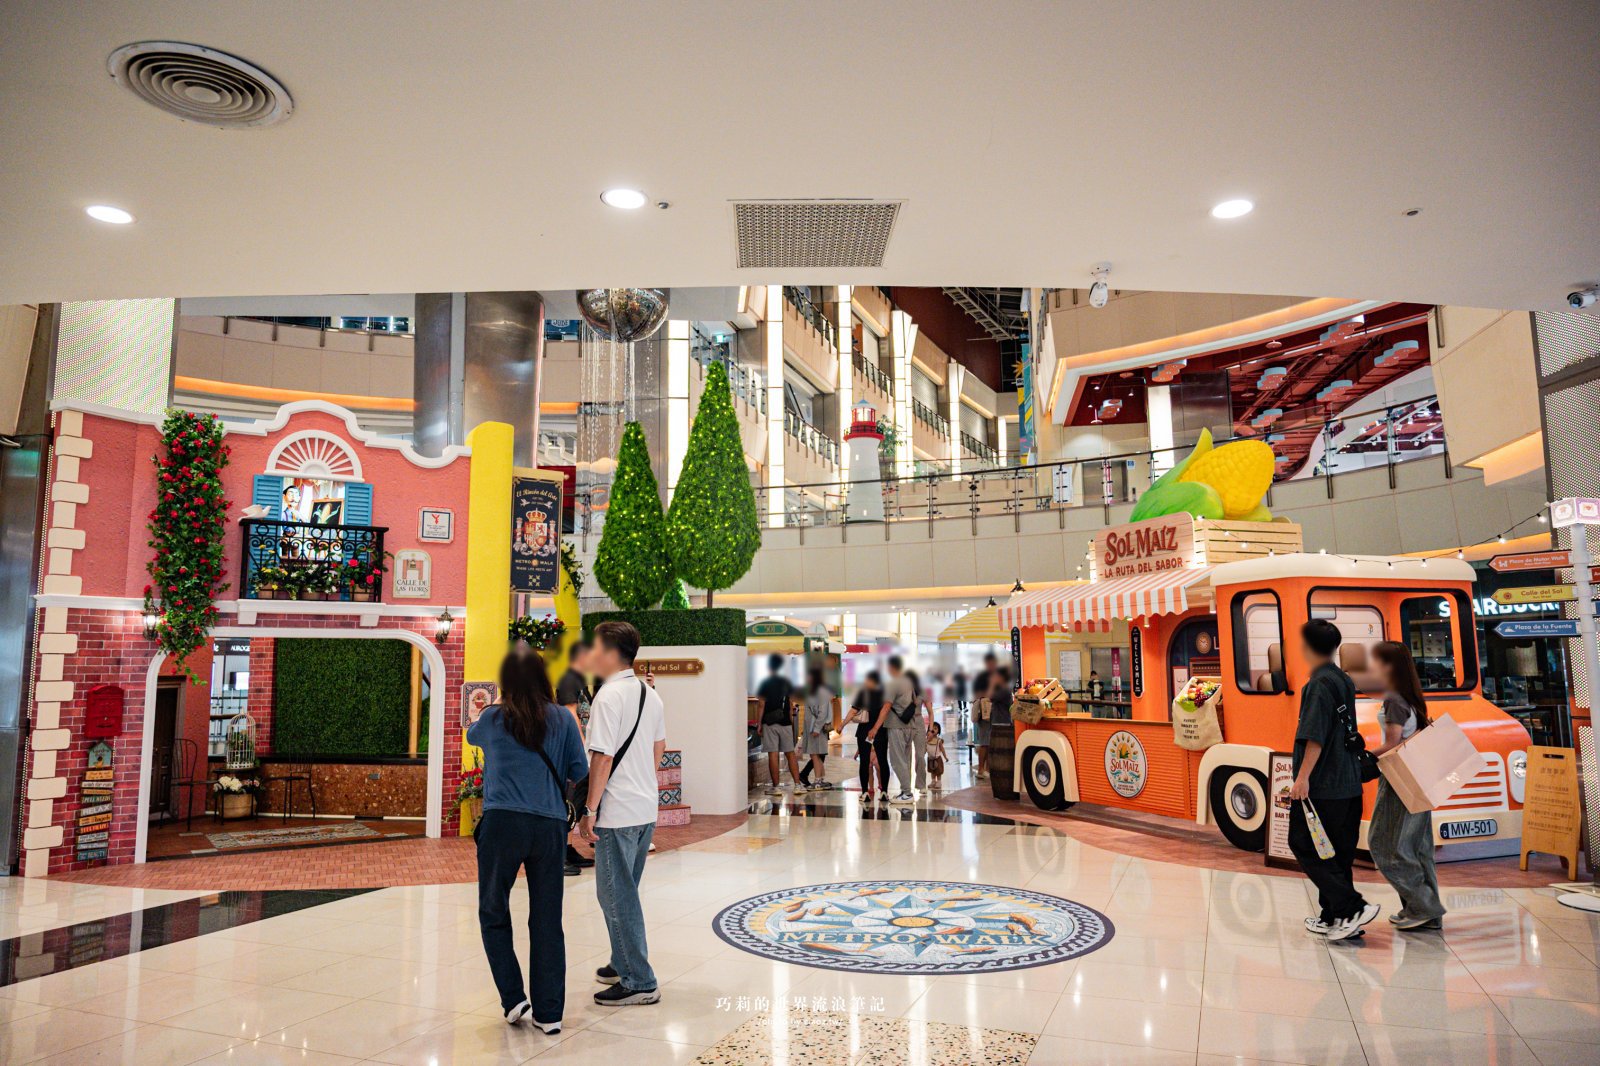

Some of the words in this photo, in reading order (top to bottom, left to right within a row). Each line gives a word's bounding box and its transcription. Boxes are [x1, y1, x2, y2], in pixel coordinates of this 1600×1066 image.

[1104, 531, 1135, 566] SOL
[1104, 568, 1113, 578] LA
[1115, 565, 1135, 577] RUTA
[1138, 562, 1152, 574] DEL
[1155, 557, 1183, 571] SABOR
[1133, 636, 1141, 686] WELCOME
[1110, 758, 1122, 772] SOL
[1275, 762, 1288, 773] SOL
[83, 804, 110, 815] RELAX
[1451, 821, 1491, 836] MW-501
[781, 932, 917, 944] METRO
[931, 932, 1048, 945] WALK
